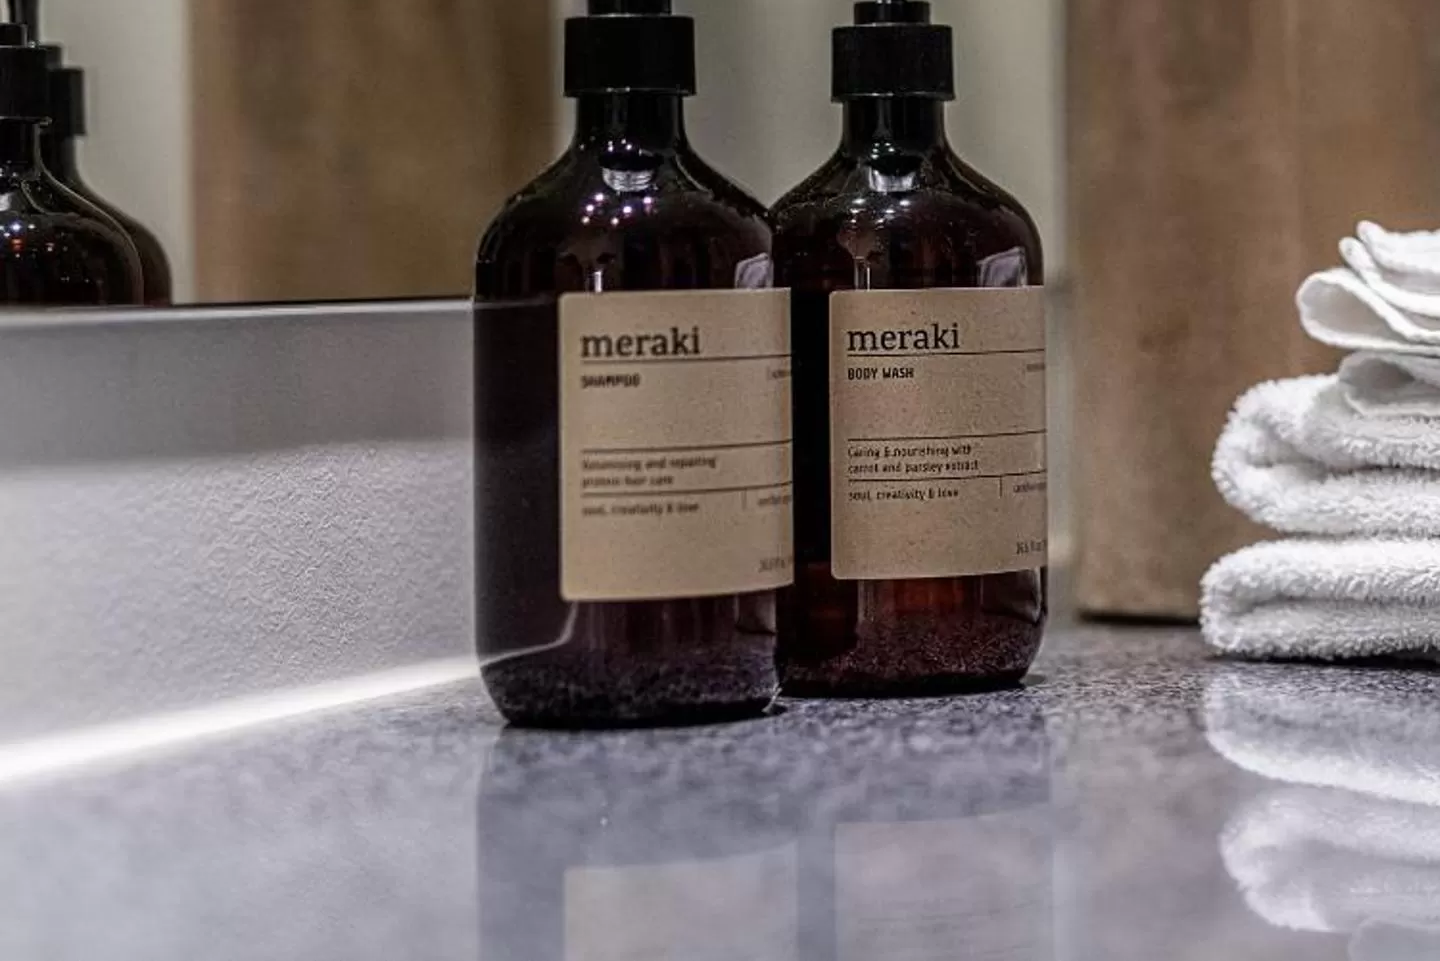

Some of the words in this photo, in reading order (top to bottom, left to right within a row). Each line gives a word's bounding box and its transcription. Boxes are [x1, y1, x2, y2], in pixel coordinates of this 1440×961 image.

[581, 325, 700, 358] meraki
[847, 322, 960, 352] meraki
[848, 368, 878, 380] BODY
[882, 367, 914, 379] WASH
[581, 373, 640, 389] SHAMPOO
[847, 447, 880, 460] Caring
[894, 446, 949, 459] nourishing
[848, 463, 878, 474] carrot
[882, 462, 901, 472] and
[905, 461, 943, 474] parsley
[877, 490, 925, 501] creativity
